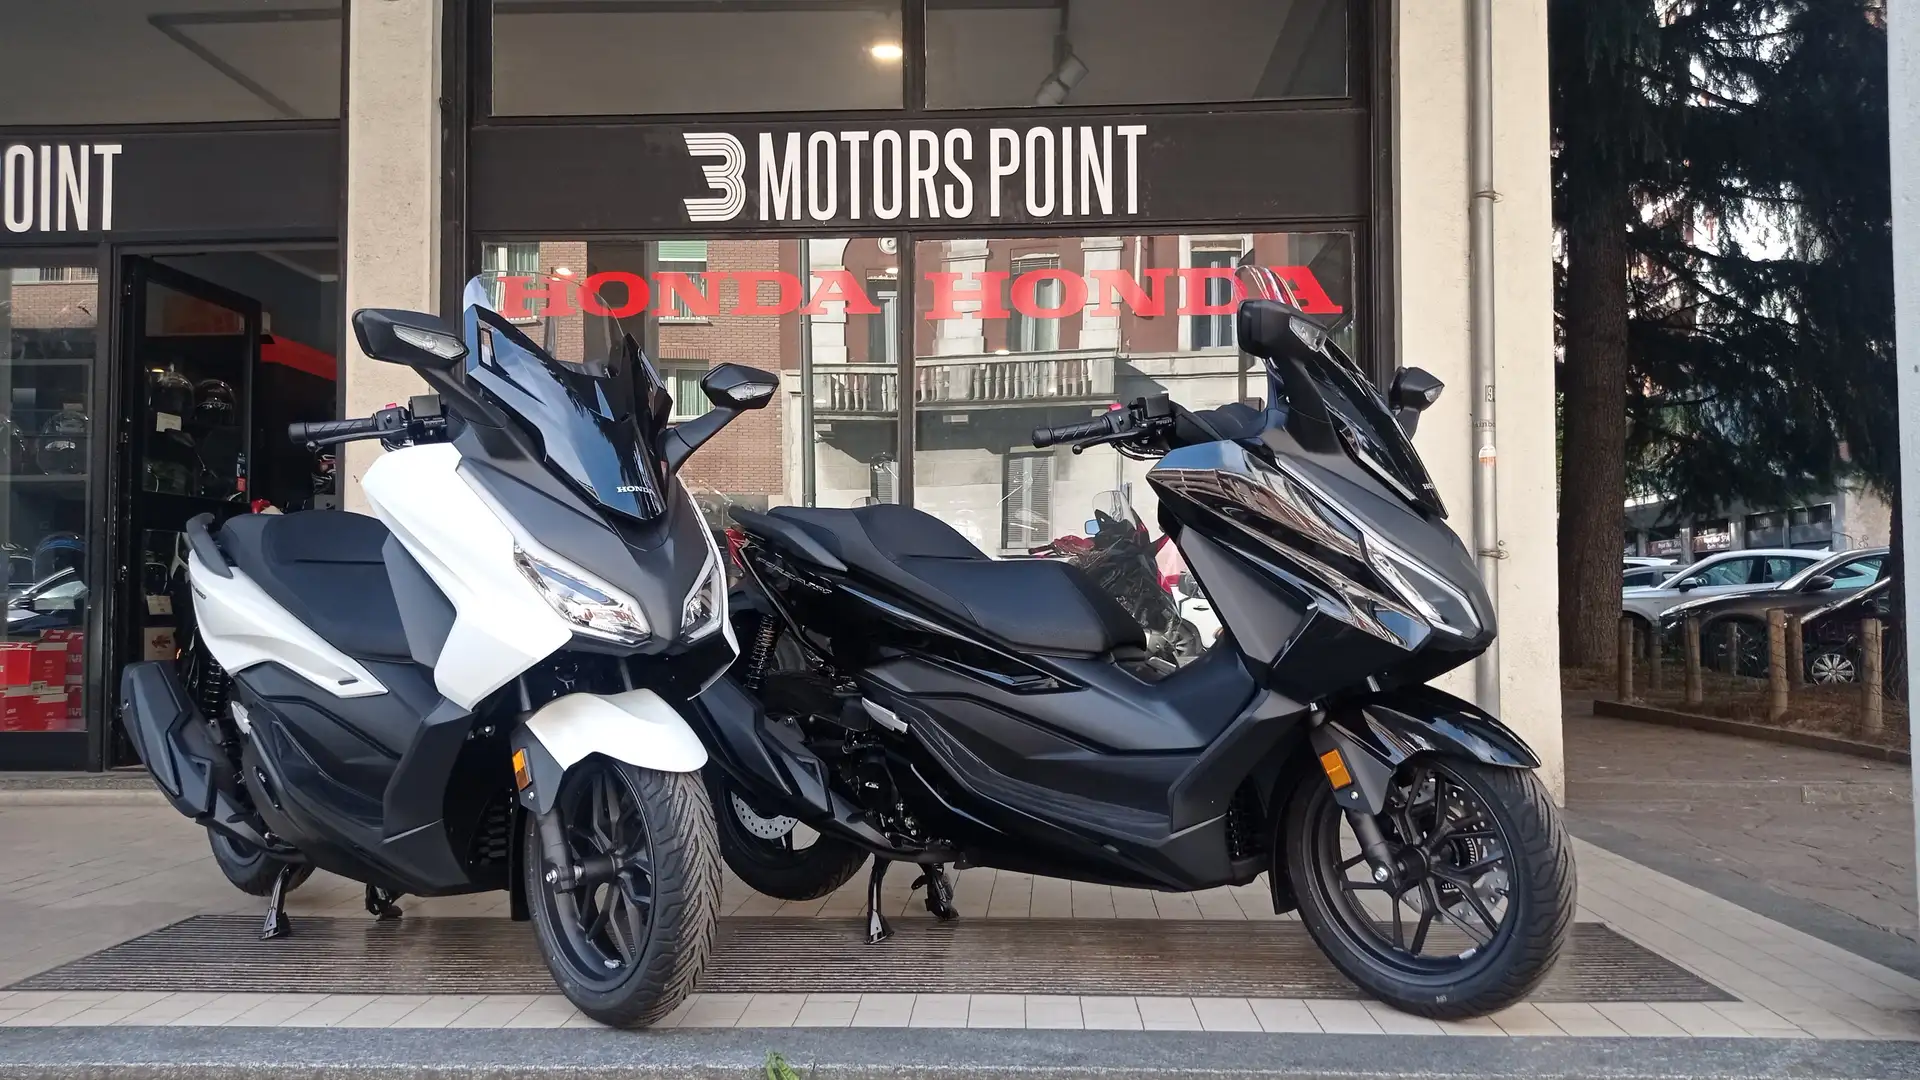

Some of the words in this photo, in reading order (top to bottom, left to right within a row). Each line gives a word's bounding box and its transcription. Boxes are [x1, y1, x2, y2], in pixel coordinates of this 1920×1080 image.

[0, 144, 122, 233] OINT
[758, 128, 974, 221] MOTORS
[989, 125, 1147, 217] POINT
[498, 270, 881, 319] HONDA
[924, 266, 1343, 320] HONDA
